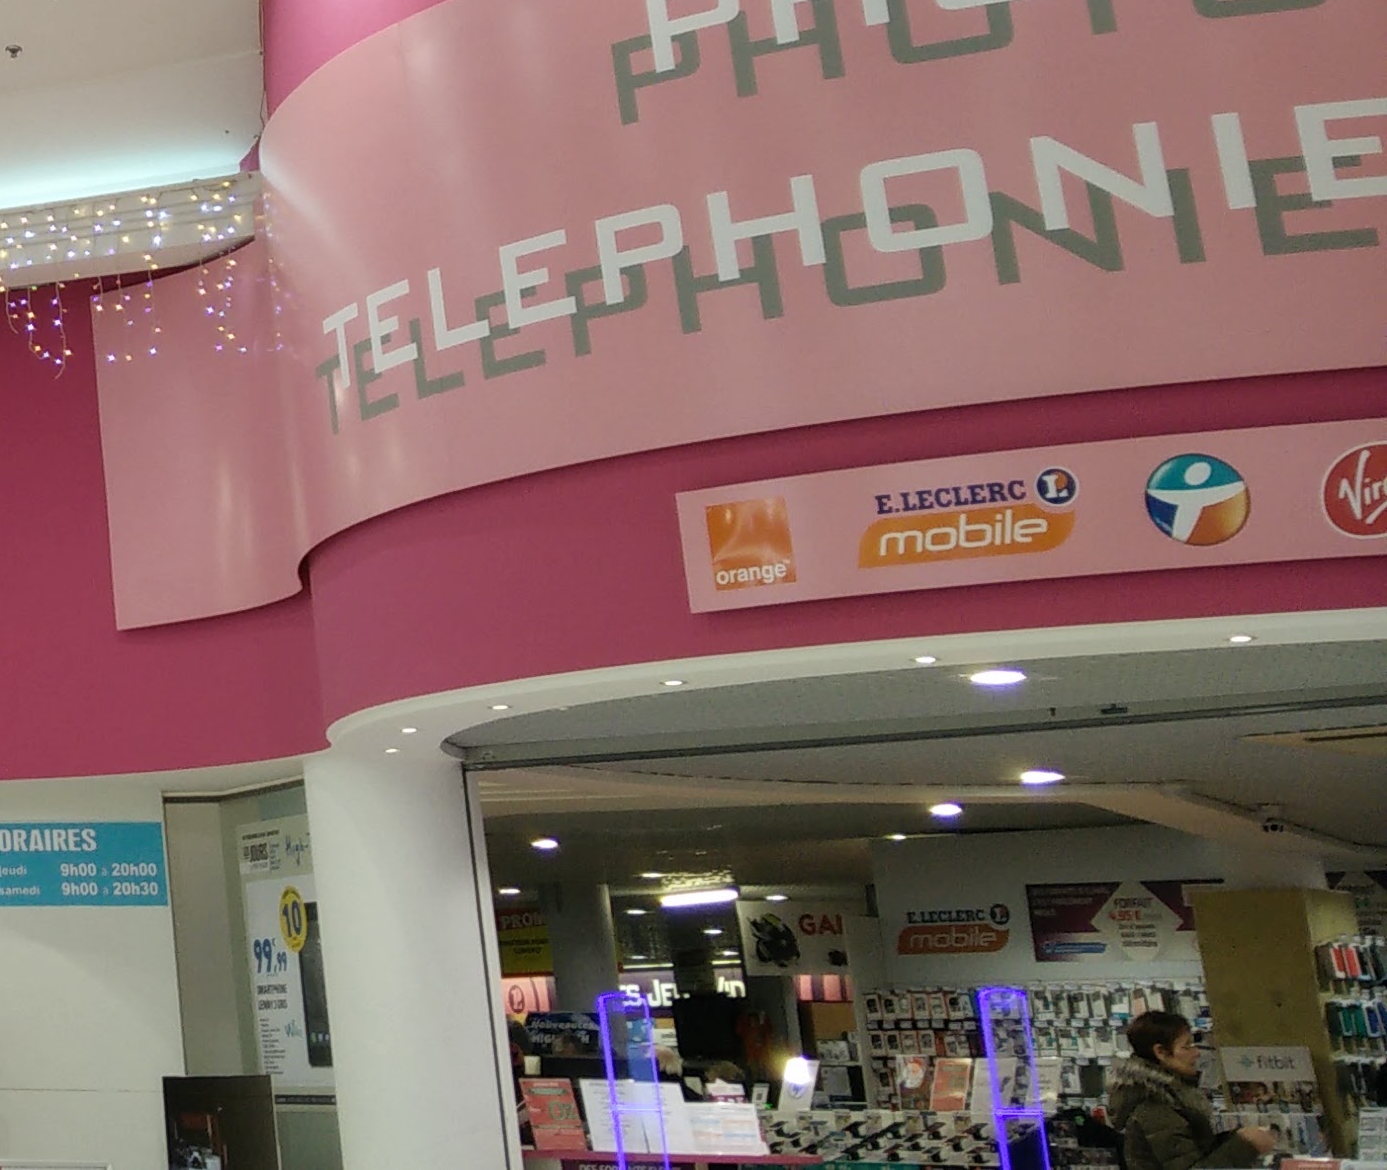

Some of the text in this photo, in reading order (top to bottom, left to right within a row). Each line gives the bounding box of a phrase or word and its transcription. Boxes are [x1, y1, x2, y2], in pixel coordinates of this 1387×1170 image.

[322, 97, 1387, 388] TELEPHONIE
[875, 479, 1027, 516] E.LECLERC
[878, 508, 1048, 557] mobile
[715, 560, 788, 587] orange
[60, 862, 97, 877] 9h00
[111, 862, 158, 877] 20h00
[61, 882, 98, 896] 9h00
[113, 882, 159, 896] 20h30
[282, 900, 303, 938] 10
[906, 909, 986, 924] E.LECLERC
[909, 926, 997, 949] mobile
[1256, 1054, 1296, 1070] fitbit
